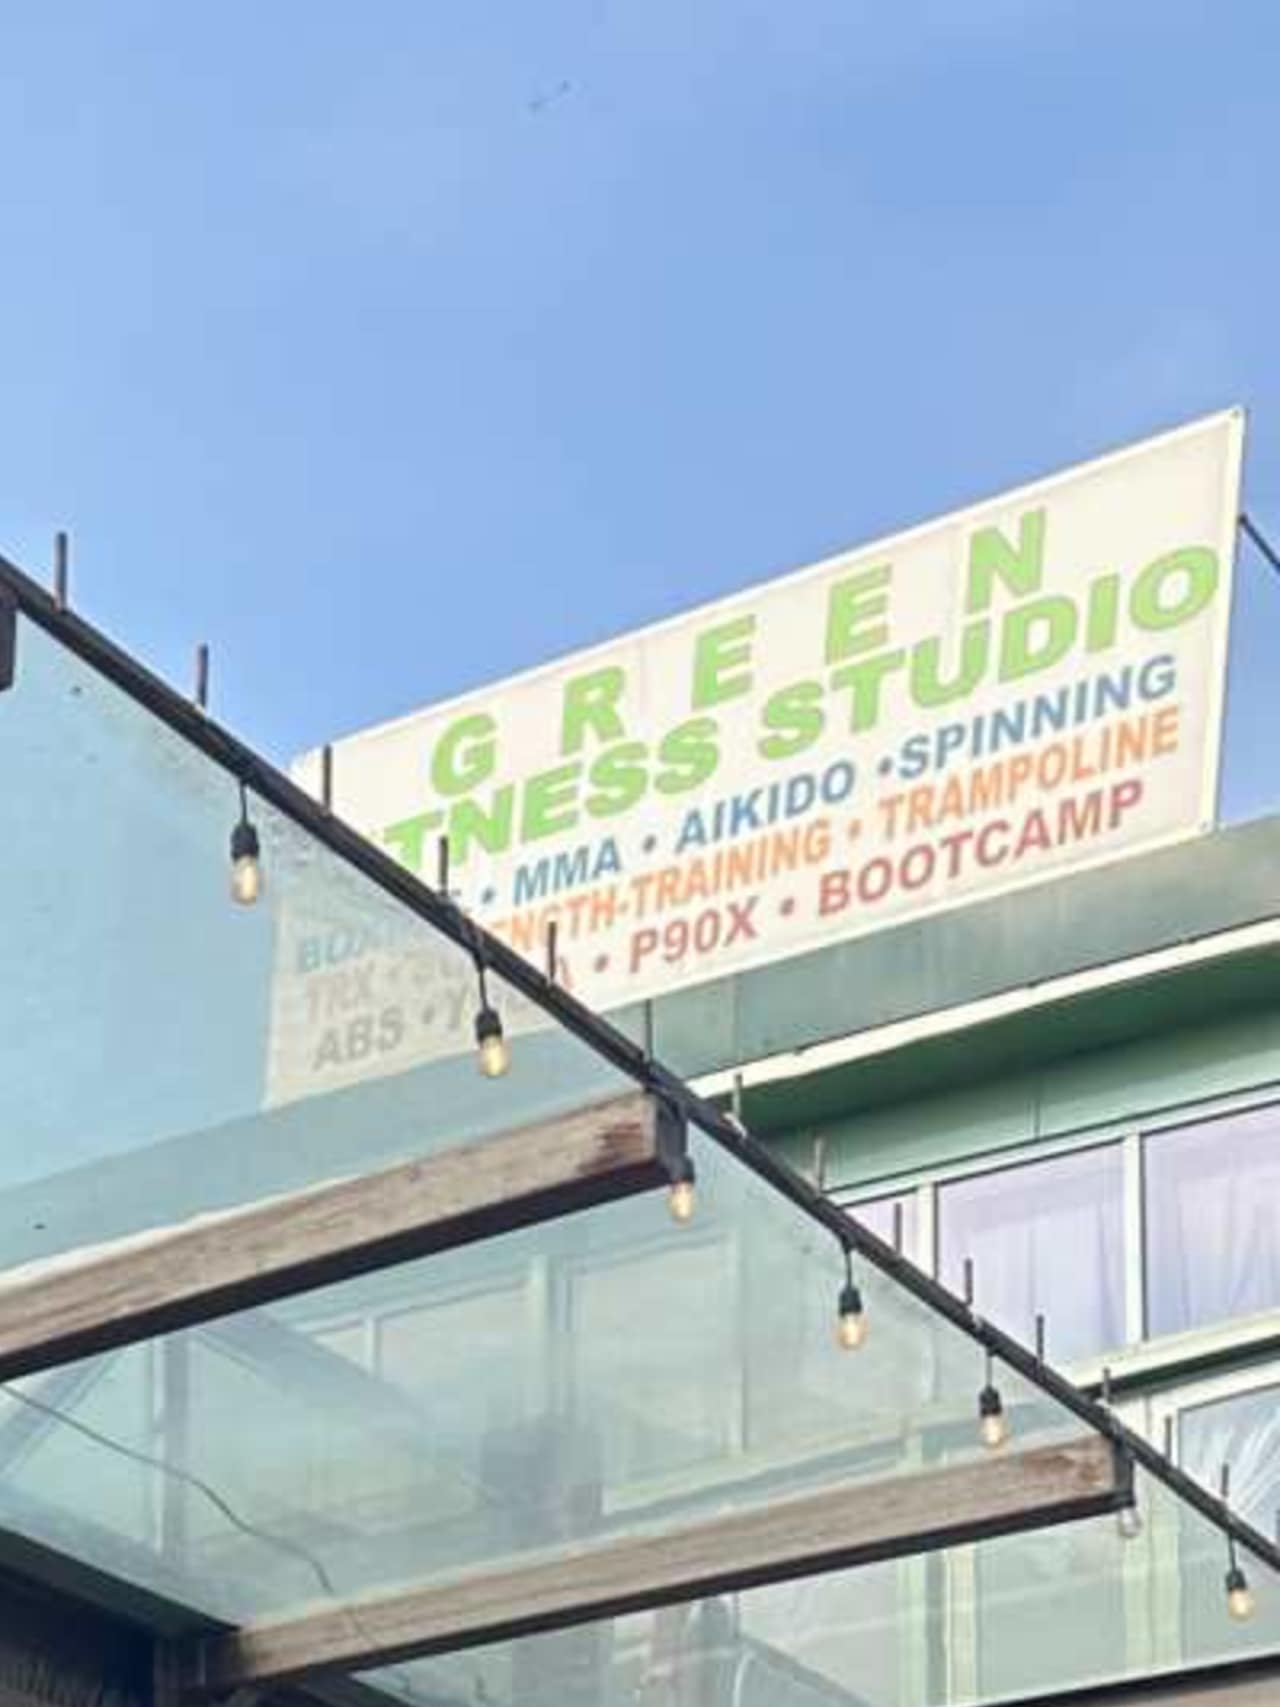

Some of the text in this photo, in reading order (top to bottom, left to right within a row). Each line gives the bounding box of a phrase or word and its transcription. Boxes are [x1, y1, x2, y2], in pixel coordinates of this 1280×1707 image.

[383, 545, 1220, 873] TNESS STUDIO
[430, 507, 1047, 797] GREEN
[512, 839, 621, 905] MMA
[674, 760, 856, 854] AIKIDO
[898, 653, 1178, 780] SPINNING
[878, 705, 1180, 842] TRAMPOLINE
[312, 1011, 405, 1072] ABS
[629, 908, 758, 974] P90X
[818, 779, 1144, 917] BOOTCAMP
